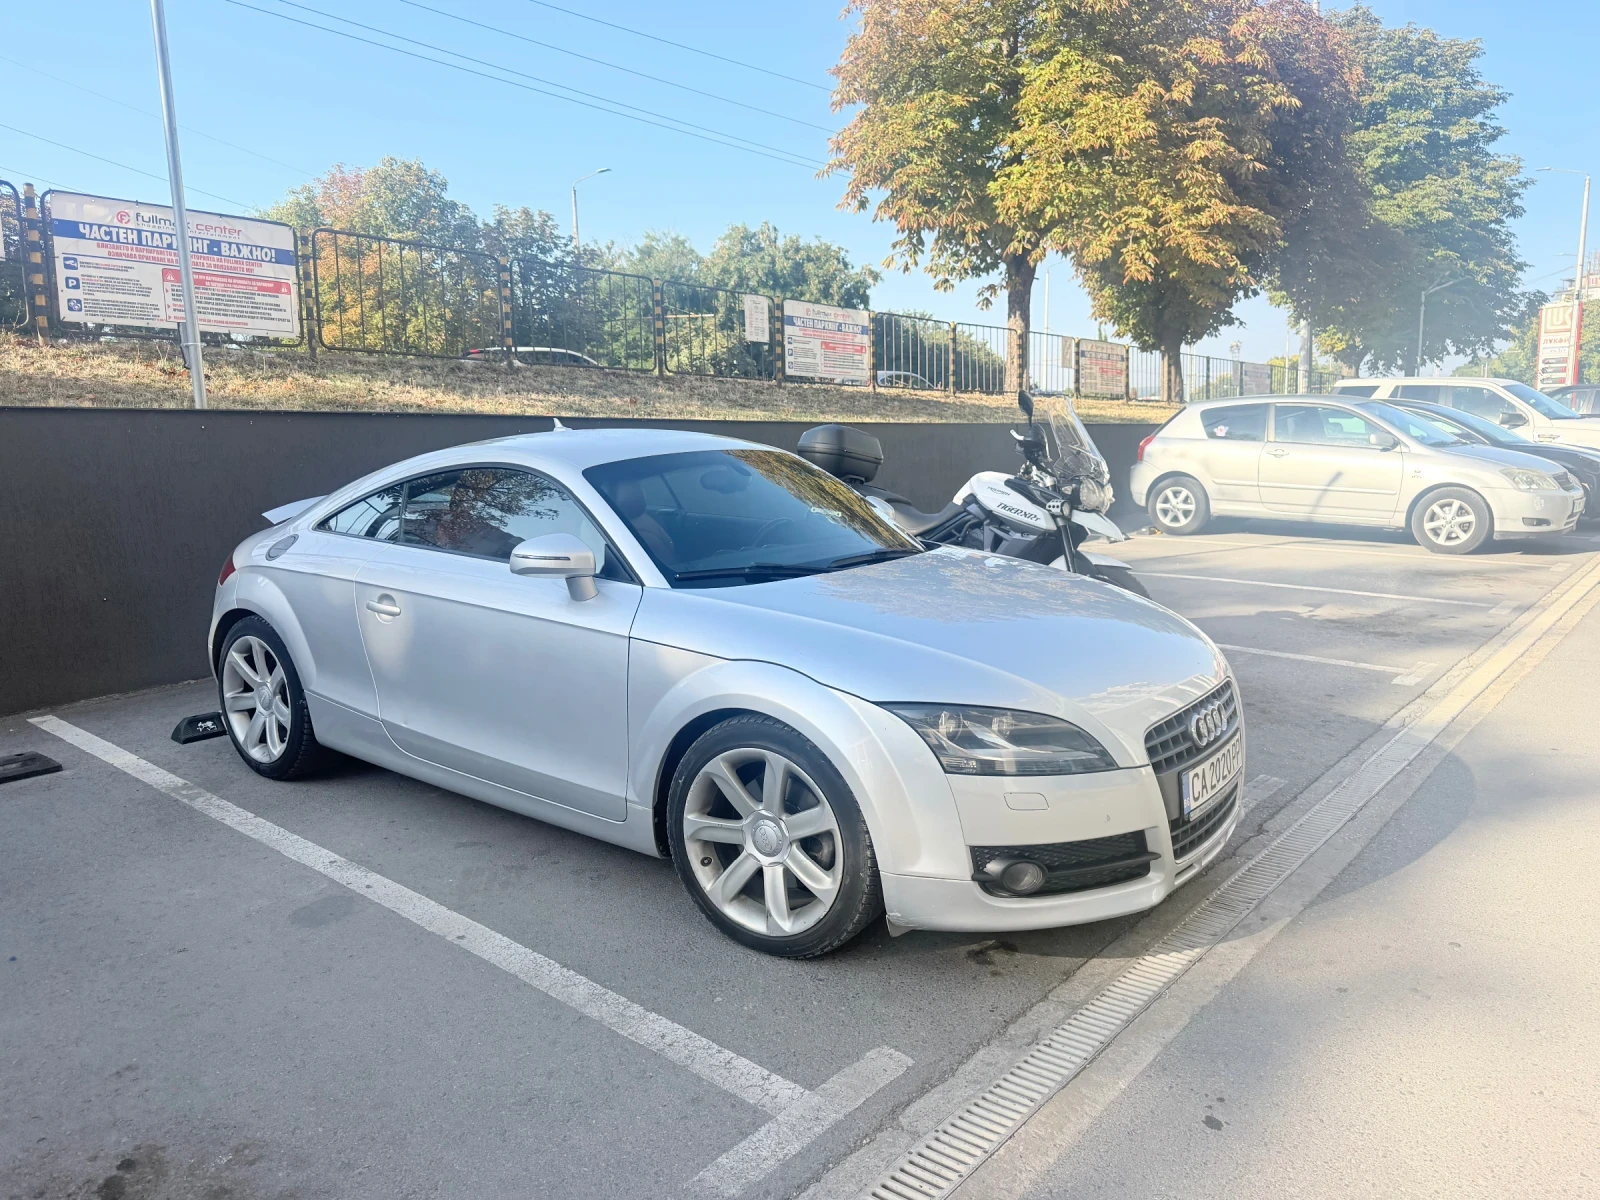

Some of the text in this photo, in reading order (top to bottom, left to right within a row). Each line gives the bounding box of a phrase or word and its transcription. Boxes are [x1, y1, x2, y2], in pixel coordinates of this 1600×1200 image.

[136, 213, 242, 236] fullmx center
[190, 230, 240, 240] ntertainment
[79, 223, 138, 244] ЧАСТЕН
[221, 242, 276, 262] ВАЖНО!
[793, 316, 814, 328] ЧАСТЕН
[814, 319, 839, 331] ПАРКИНГ
[1191, 768, 1208, 803] CA
[1209, 748, 1231, 791] 2020
